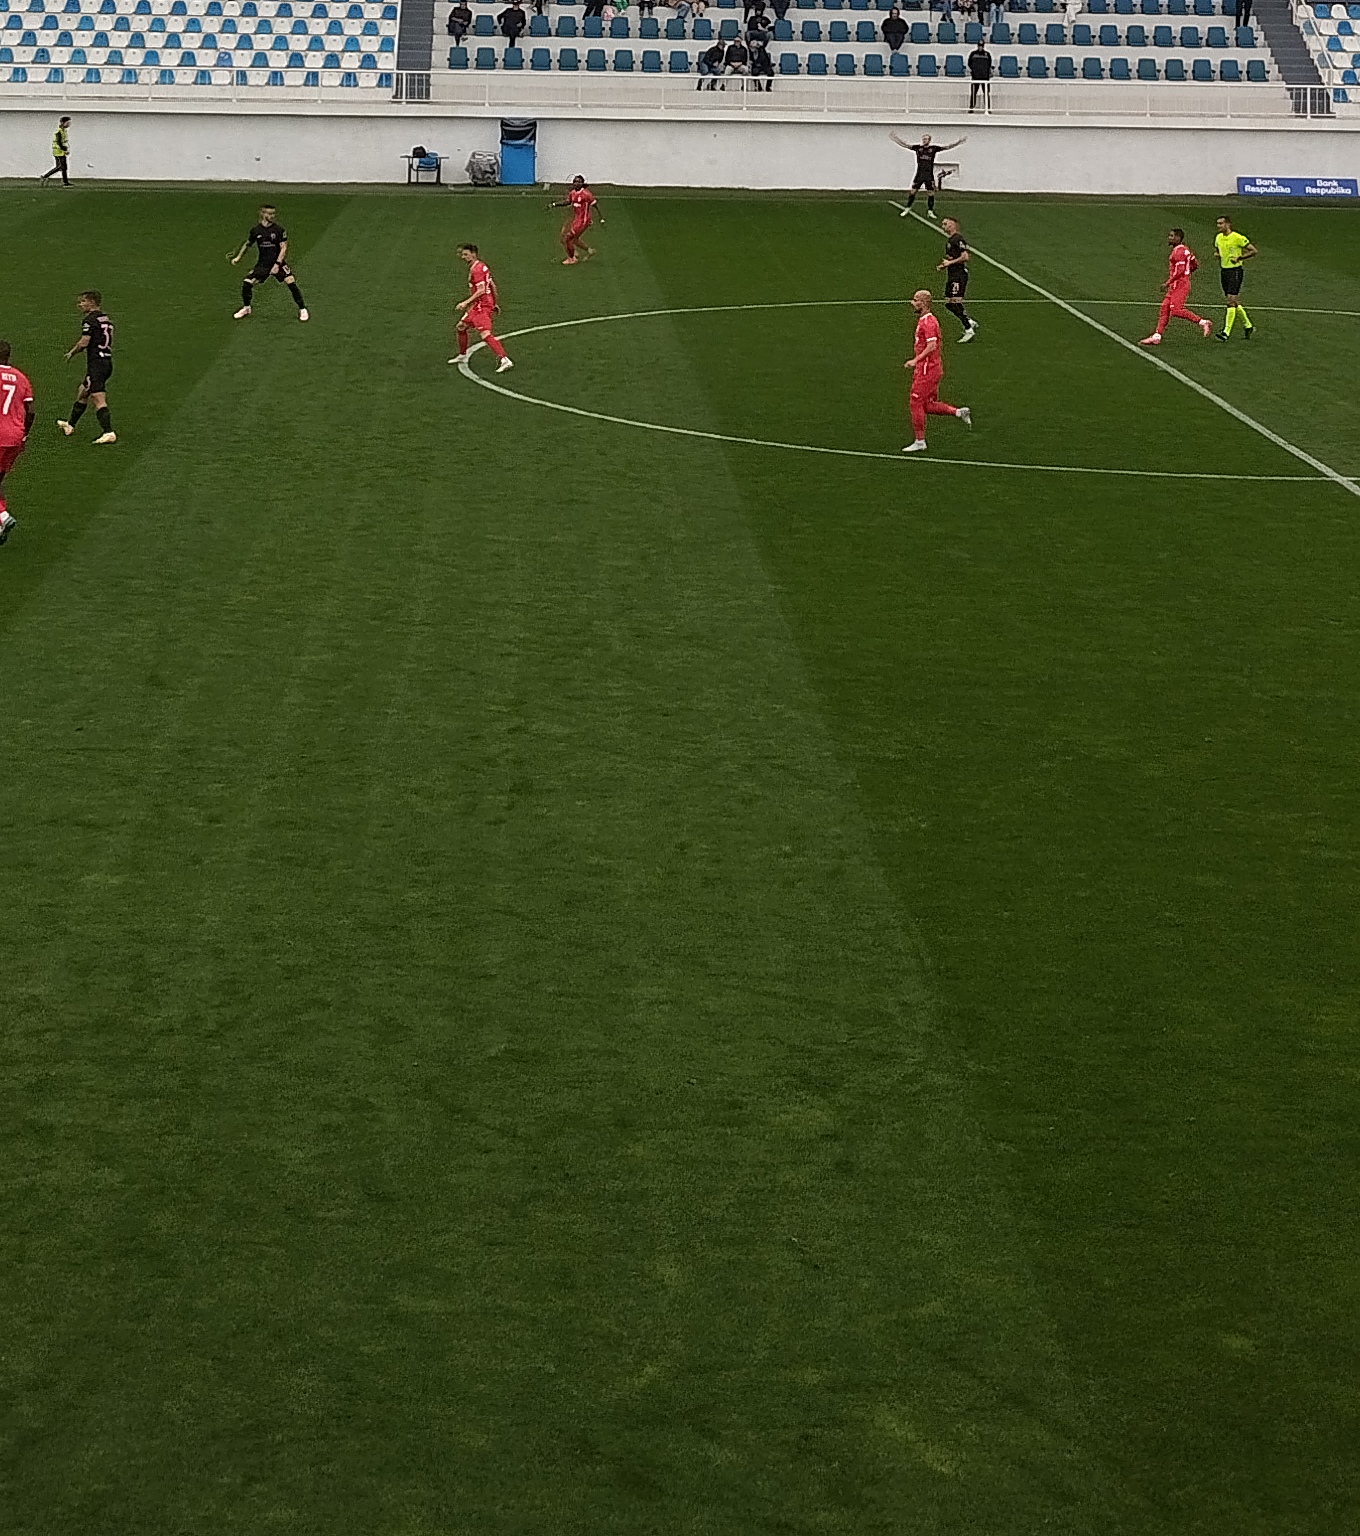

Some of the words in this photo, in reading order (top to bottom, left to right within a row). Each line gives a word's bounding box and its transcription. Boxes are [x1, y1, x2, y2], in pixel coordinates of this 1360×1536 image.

[1255, 178, 1278, 186] Bank
[1316, 179, 1339, 187] Bank
[1244, 185, 1291, 195] Respublika
[1305, 186, 1352, 196] Respublika
[2, 383, 16, 415] 7
